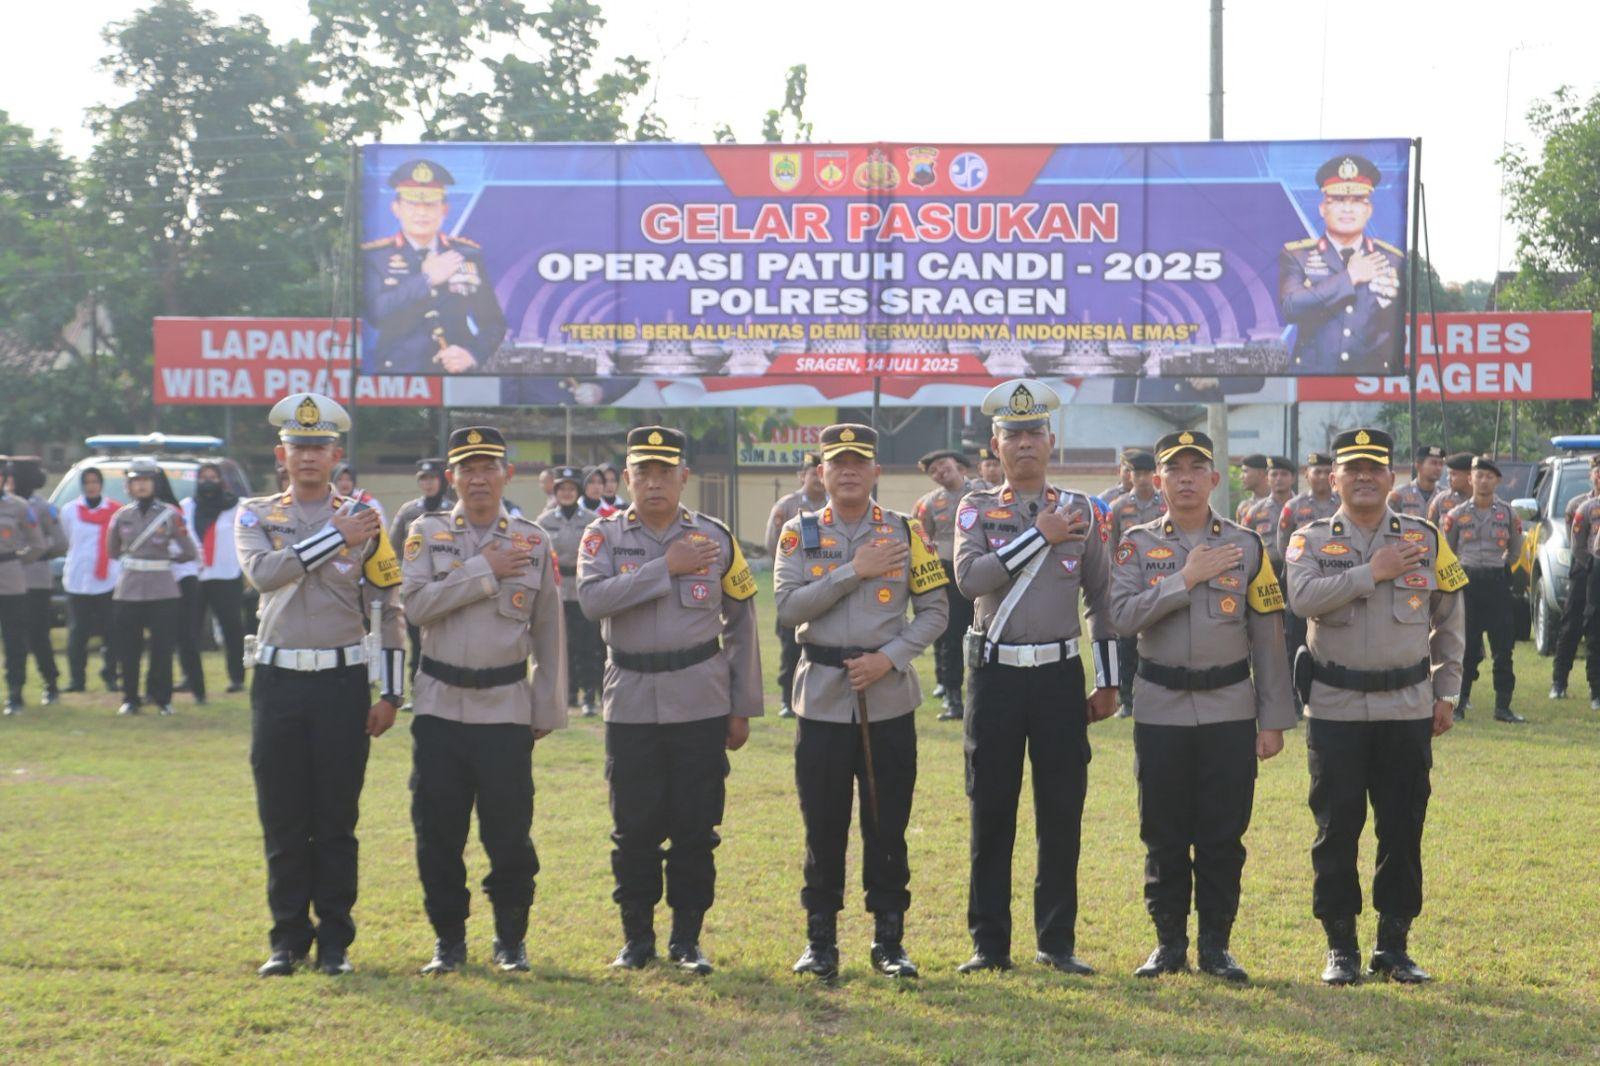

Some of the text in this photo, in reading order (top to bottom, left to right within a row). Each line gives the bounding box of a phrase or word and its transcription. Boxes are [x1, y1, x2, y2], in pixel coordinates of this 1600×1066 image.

[641, 203, 1119, 244] GELAR PASUKAN
[538, 252, 744, 281] OPERASI
[758, 252, 904, 281] PATUH
[918, 252, 1064, 281] CANDI
[1103, 251, 1224, 281] 2025
[690, 287, 1067, 315] POLRES SRAGEN
[641, 323, 805, 340] BERLALU-LINTAS
[809, 323, 861, 340] DEMI
[864, 323, 1012, 340] TERWUJUDNYA
[1015, 323, 1127, 340] INDONESIA
[1405, 323, 1532, 355] LRES
[795, 357, 959, 374] SRAGEN, 14 JULI 2025
[161, 367, 433, 398] WIRA PRATAMA
